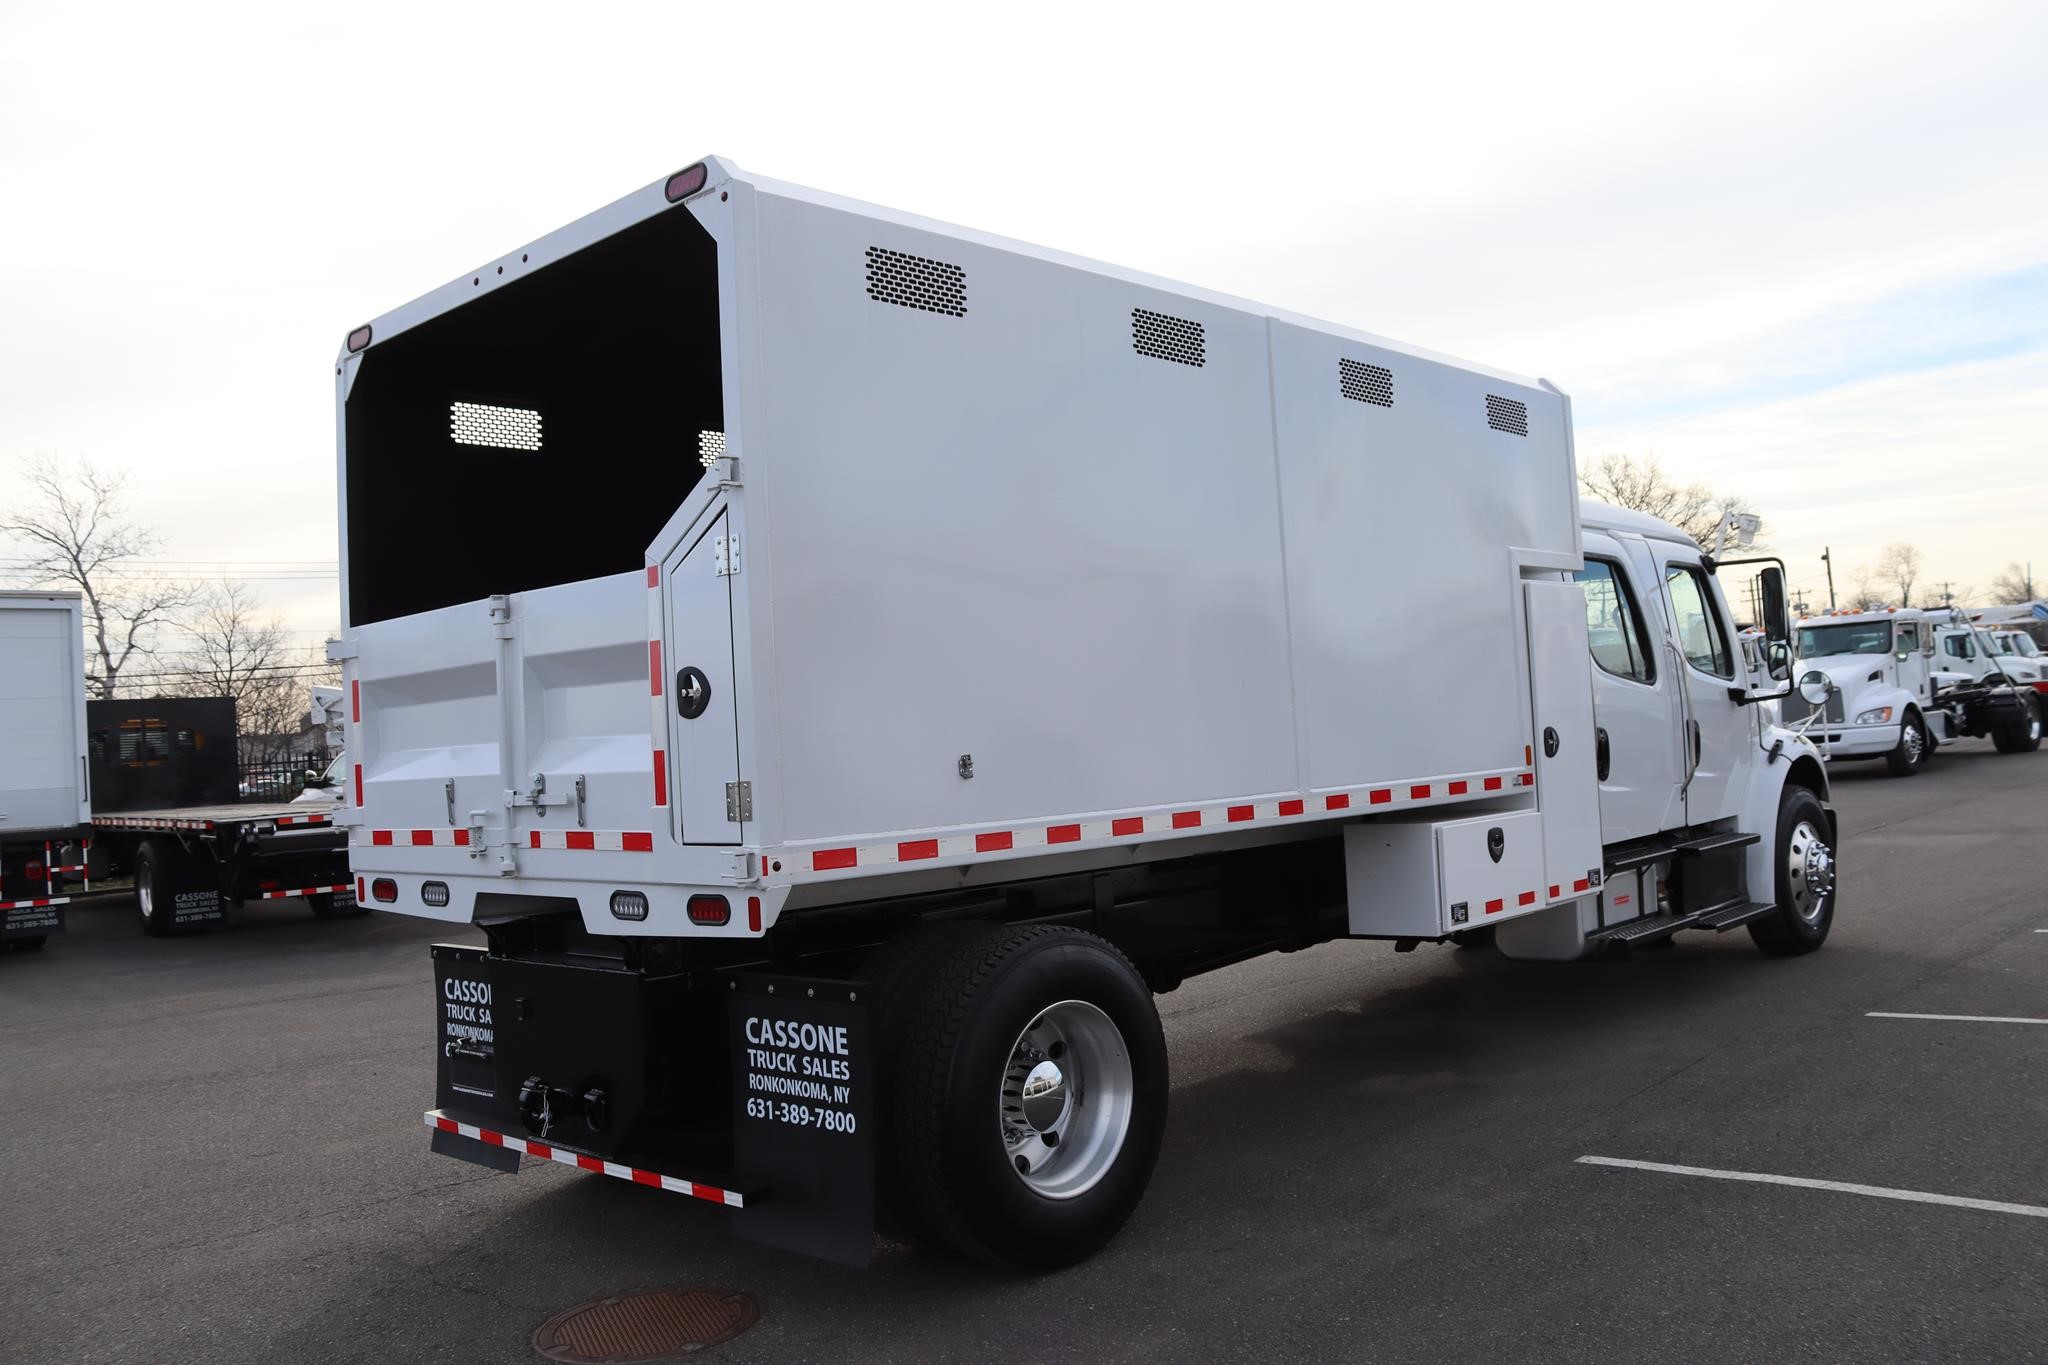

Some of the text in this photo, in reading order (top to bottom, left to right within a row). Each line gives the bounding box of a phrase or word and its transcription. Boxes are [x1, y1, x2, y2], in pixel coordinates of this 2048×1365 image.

[446, 1003, 476, 1022] TRUCK
[745, 1017, 849, 1055] CASSONE
[747, 1049, 850, 1081] TRUCK SALES
[749, 1073, 850, 1104] RONKONKOMA, NY
[747, 1097, 856, 1134] 631-389-7800
